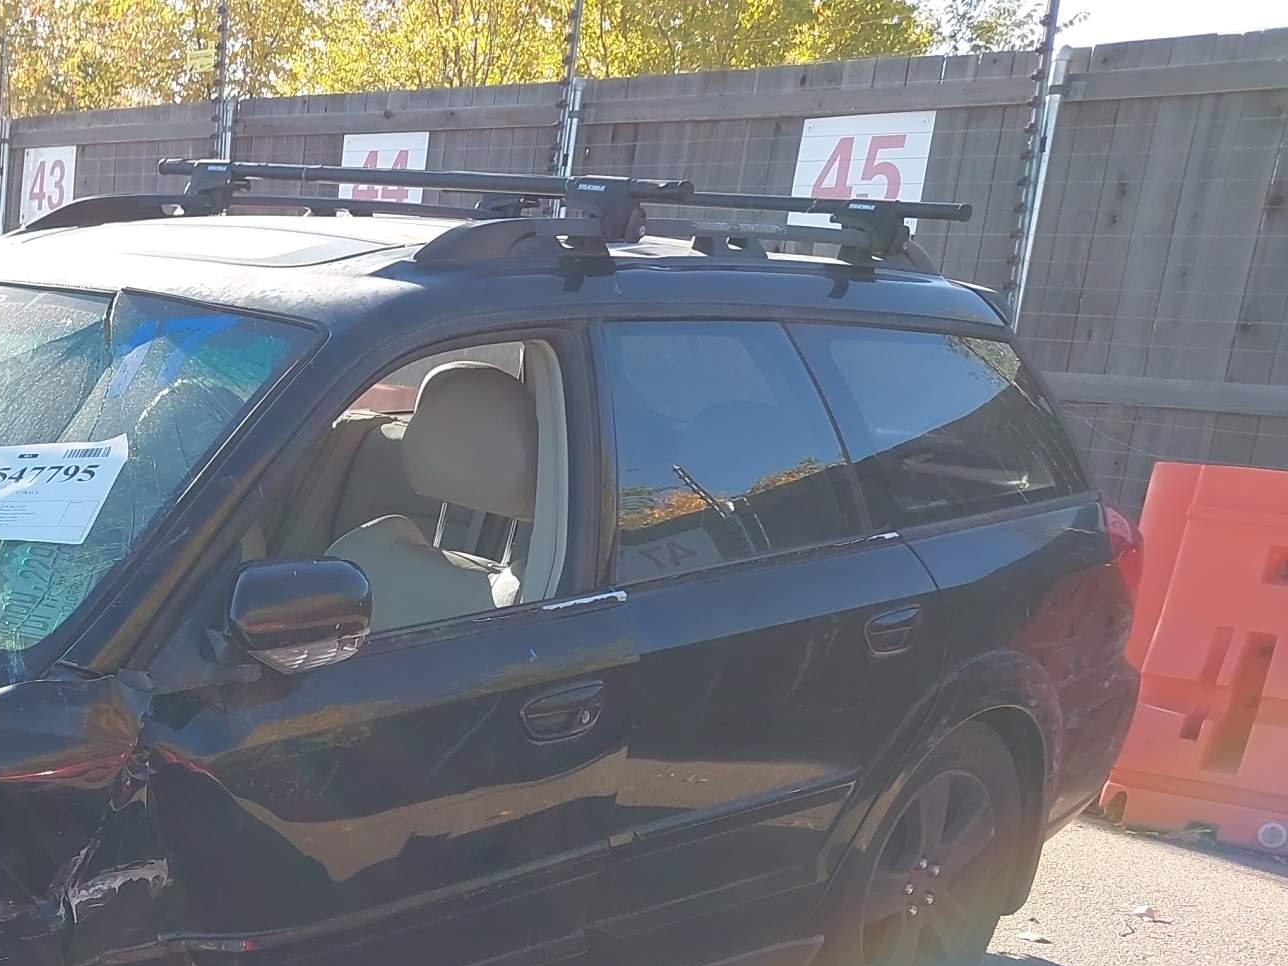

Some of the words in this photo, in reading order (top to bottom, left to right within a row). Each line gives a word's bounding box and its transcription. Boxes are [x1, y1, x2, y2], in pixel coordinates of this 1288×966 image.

[29, 160, 65, 210] 43
[352, 149, 409, 202] 44
[811, 134, 907, 200] 45
